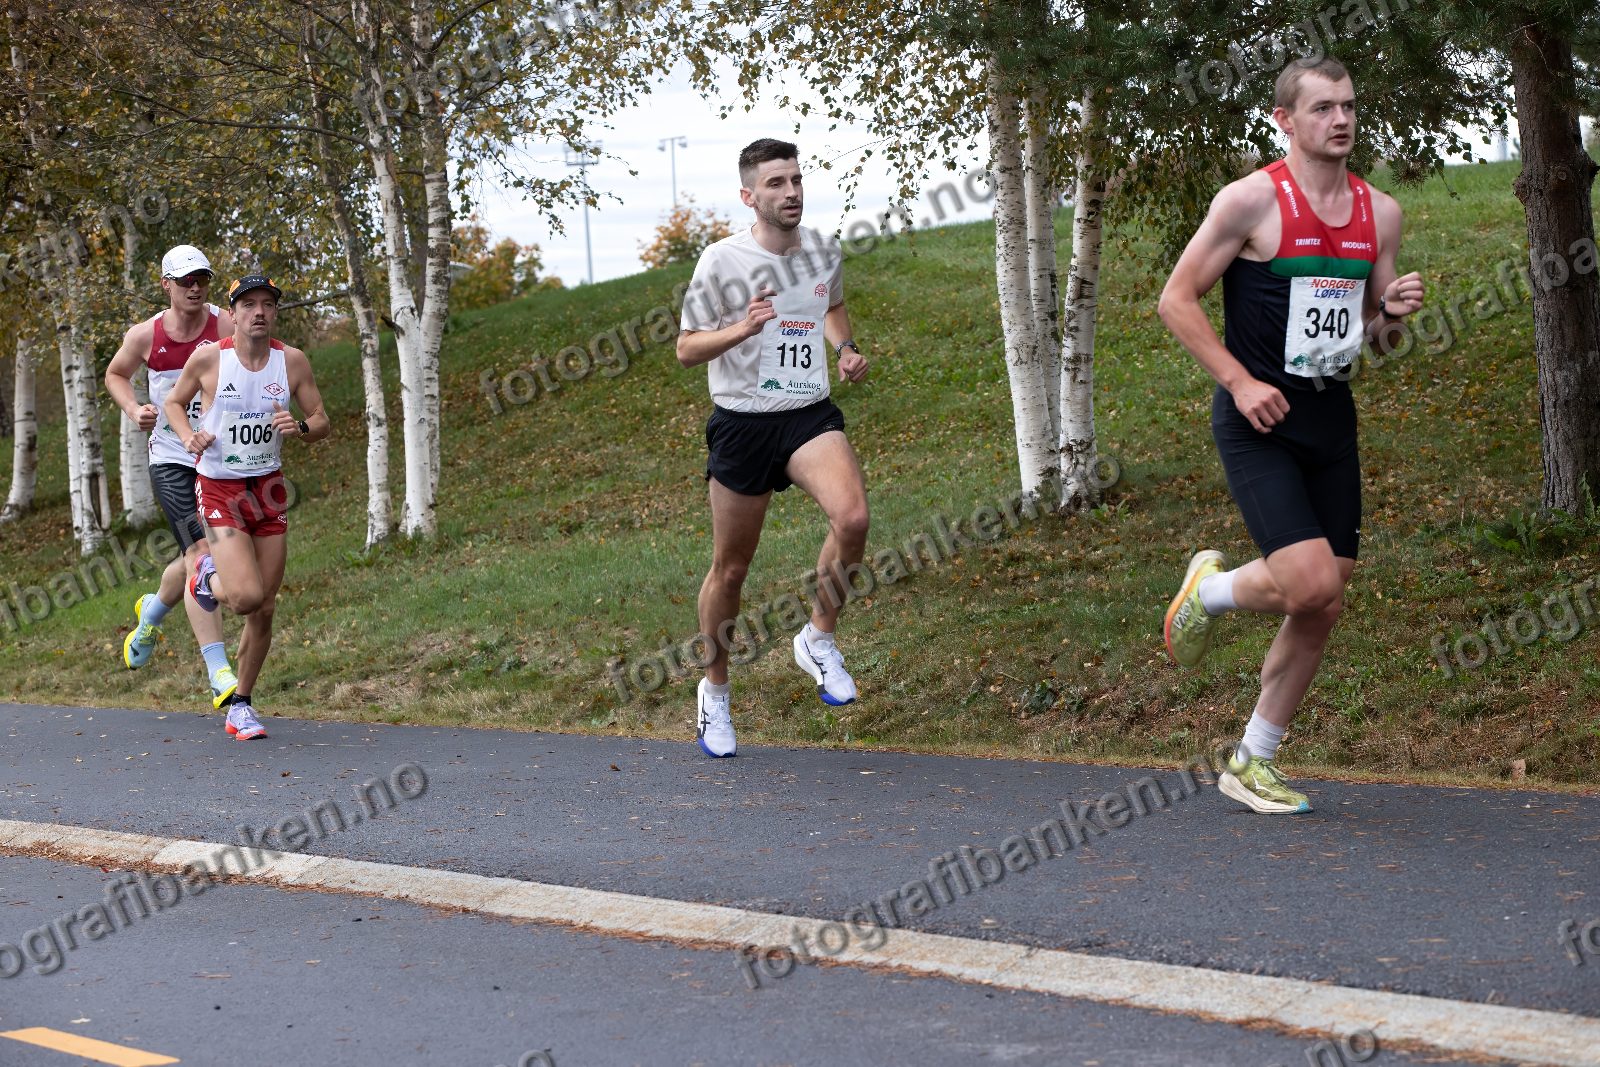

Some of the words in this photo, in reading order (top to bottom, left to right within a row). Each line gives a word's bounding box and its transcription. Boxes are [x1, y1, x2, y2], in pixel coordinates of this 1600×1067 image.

[1295, 238, 1321, 246] TRIMTEX
[1311, 278, 1357, 289] NORGES
[1314, 289, 1348, 299] LØPET
[779, 320, 816, 329] NORGES
[1304, 307, 1349, 339] 340
[781, 328, 810, 337] LØPET
[776, 342, 812, 369] 113
[786, 380, 821, 392] Aurskog
[228, 424, 273, 445] 1006
